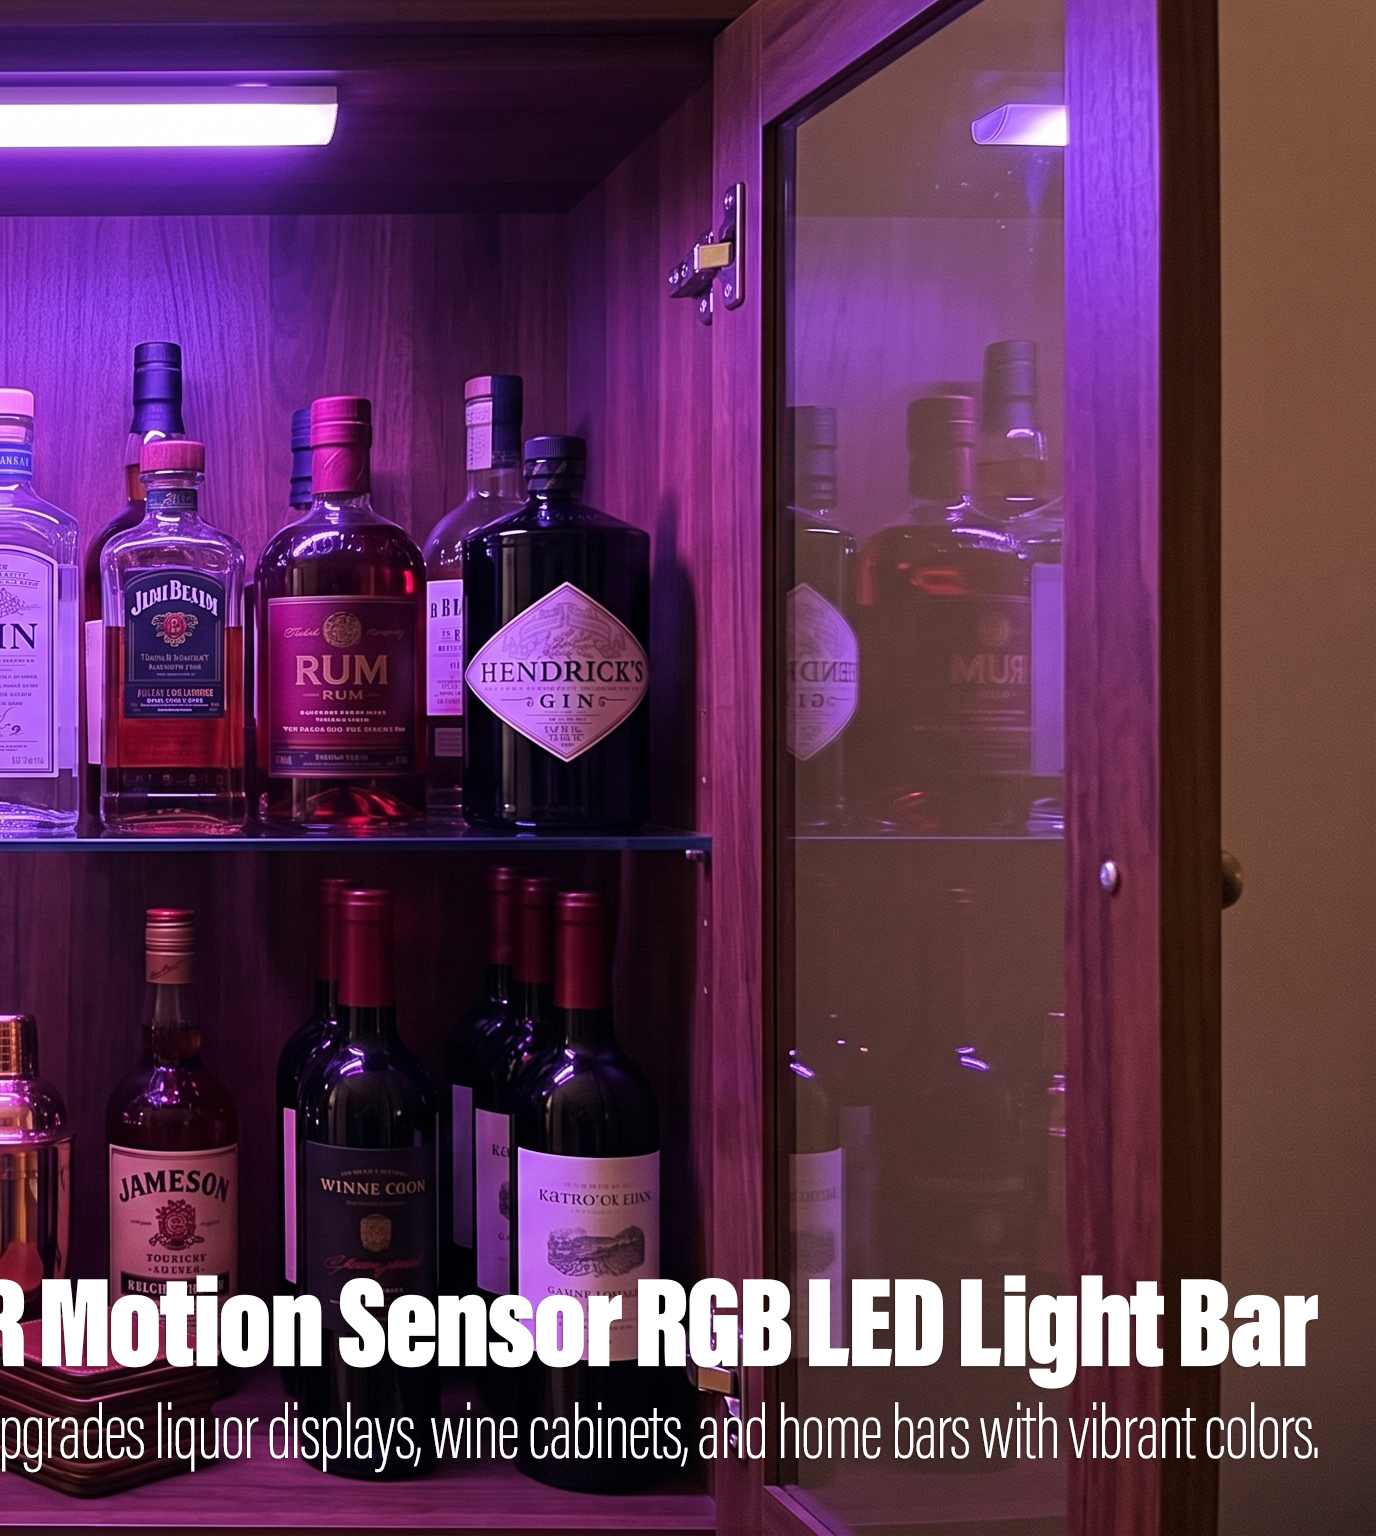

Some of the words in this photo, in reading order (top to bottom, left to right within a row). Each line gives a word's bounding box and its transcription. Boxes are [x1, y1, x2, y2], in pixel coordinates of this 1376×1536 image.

[295, 654, 389, 686] RUM
[481, 660, 644, 683] HENDRICK'S
[322, 689, 364, 701] RUM
[539, 693, 595, 709] GIN
[119, 1169, 230, 1203] JAMESON
[320, 1177, 381, 1196] WINNE
